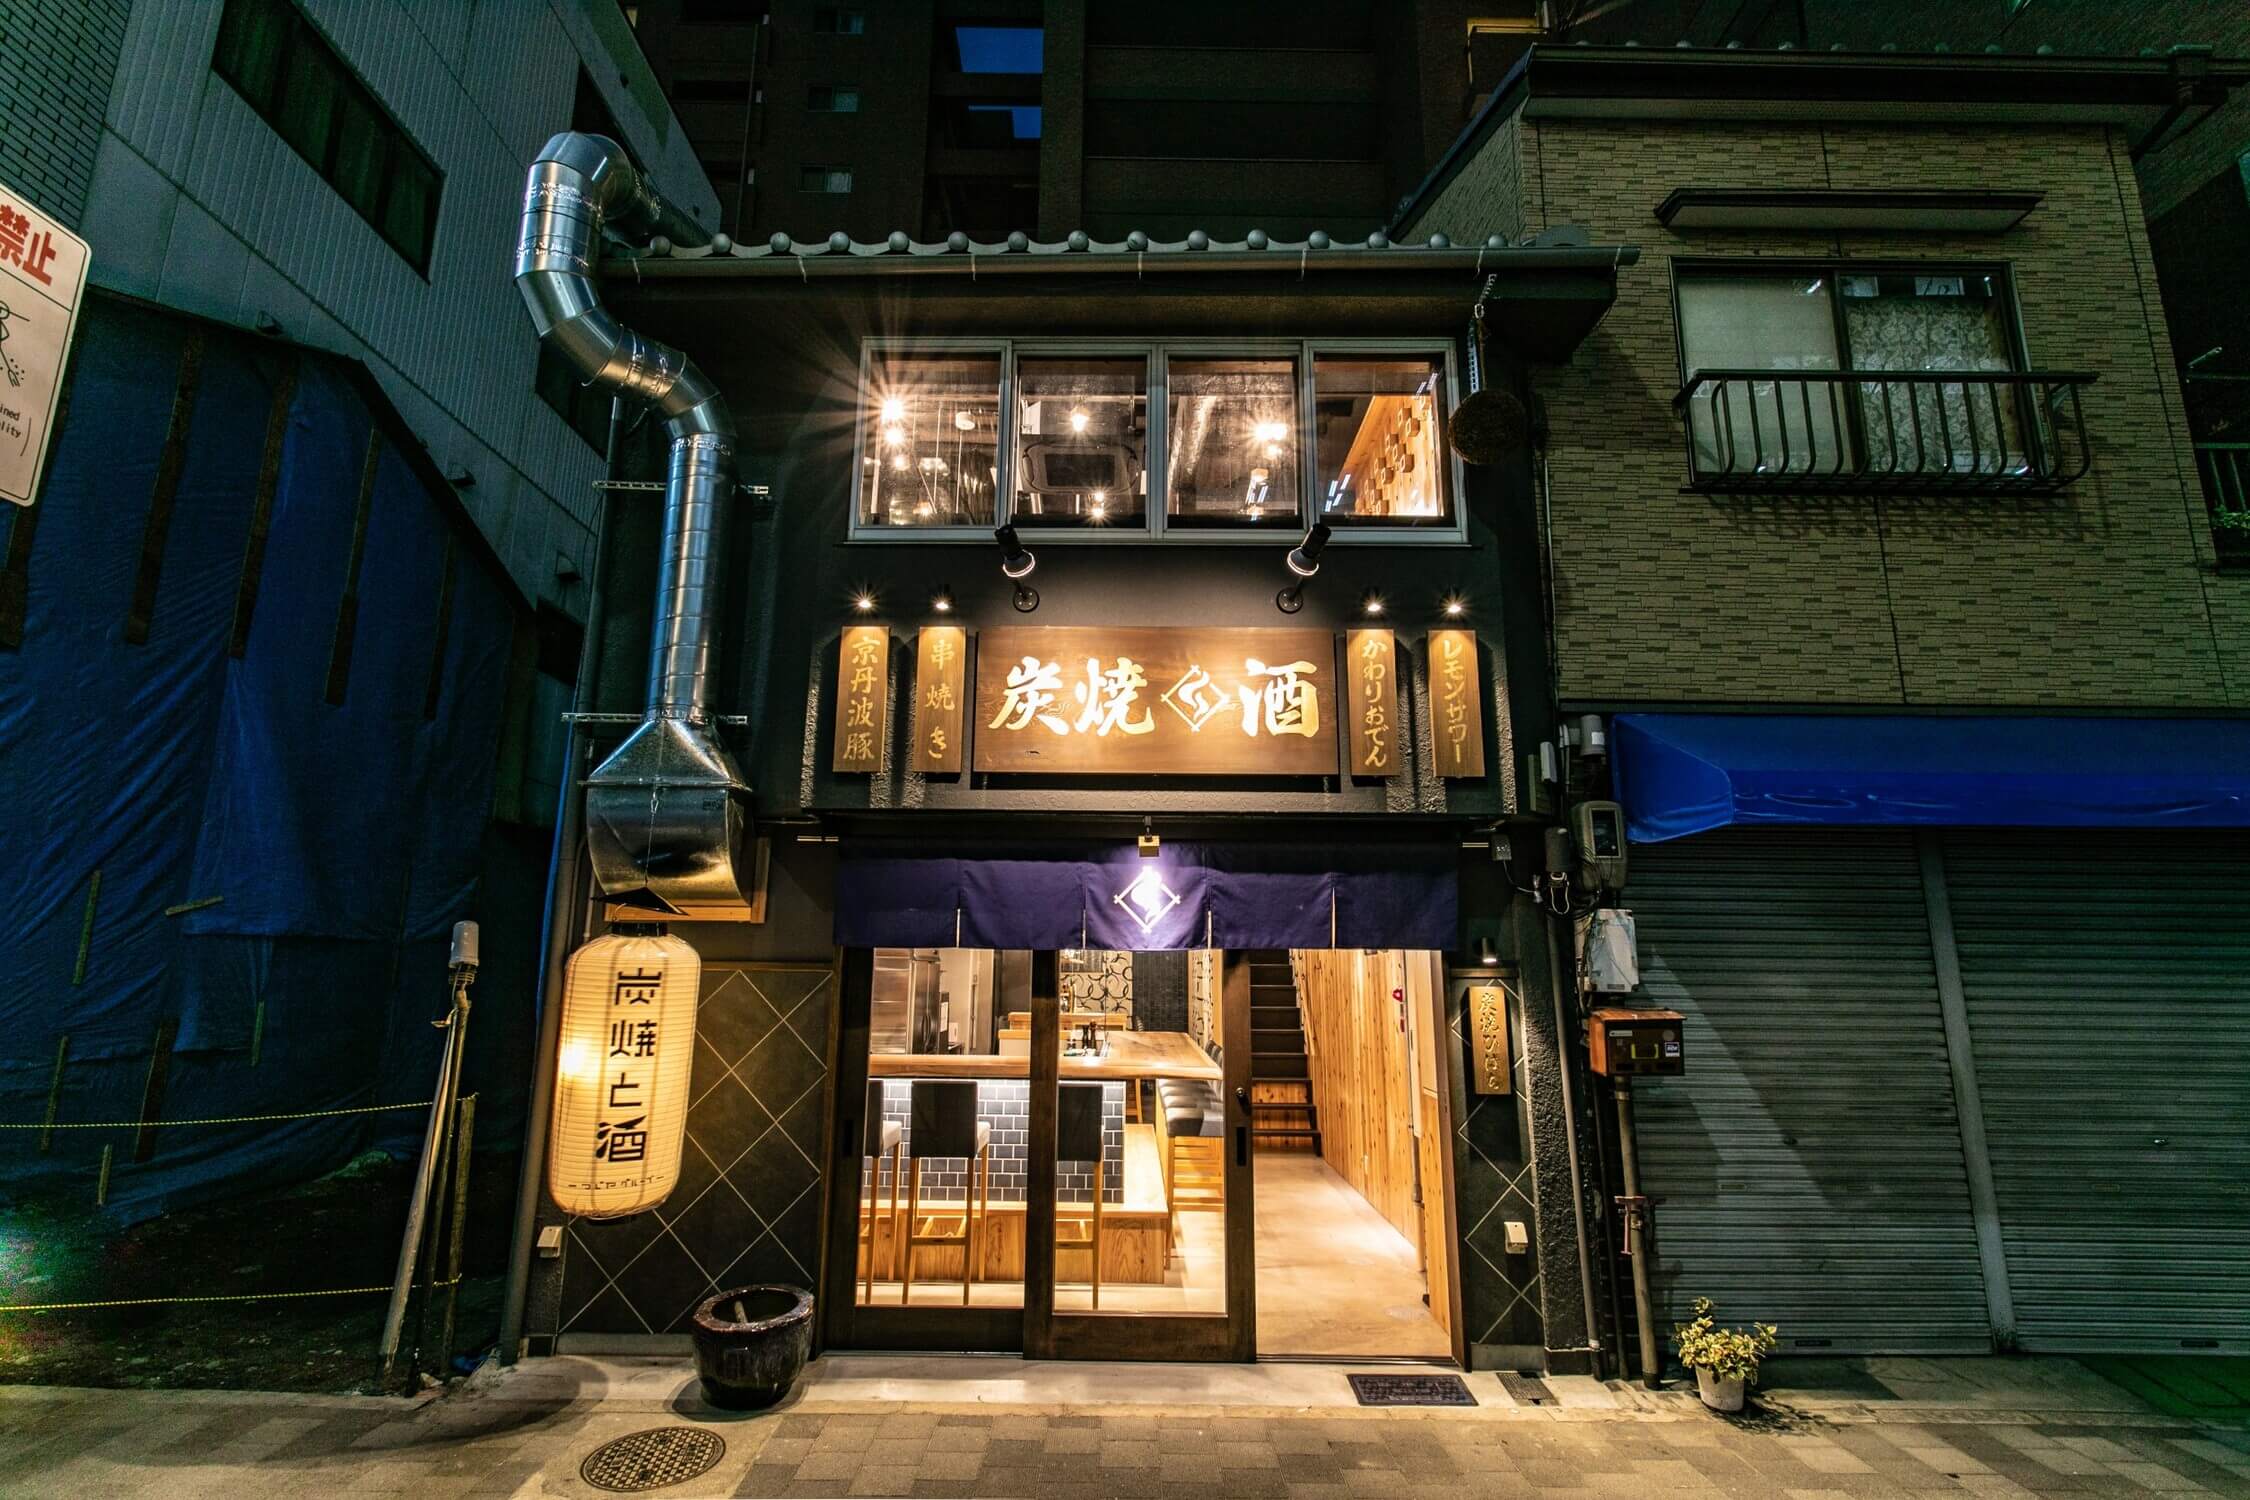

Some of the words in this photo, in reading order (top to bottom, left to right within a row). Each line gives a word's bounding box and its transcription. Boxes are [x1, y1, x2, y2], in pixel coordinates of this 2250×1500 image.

[0, 204, 57, 287] 禁止
[0, 420, 22, 439] lity
[842, 636, 881, 761] 京丹波豚
[923, 638, 956, 760] 串焼き
[1360, 638, 1390, 768] かわりおでん
[1442, 638, 1468, 763] レモンサワー
[594, 966, 663, 1164] 炭焼と酒
